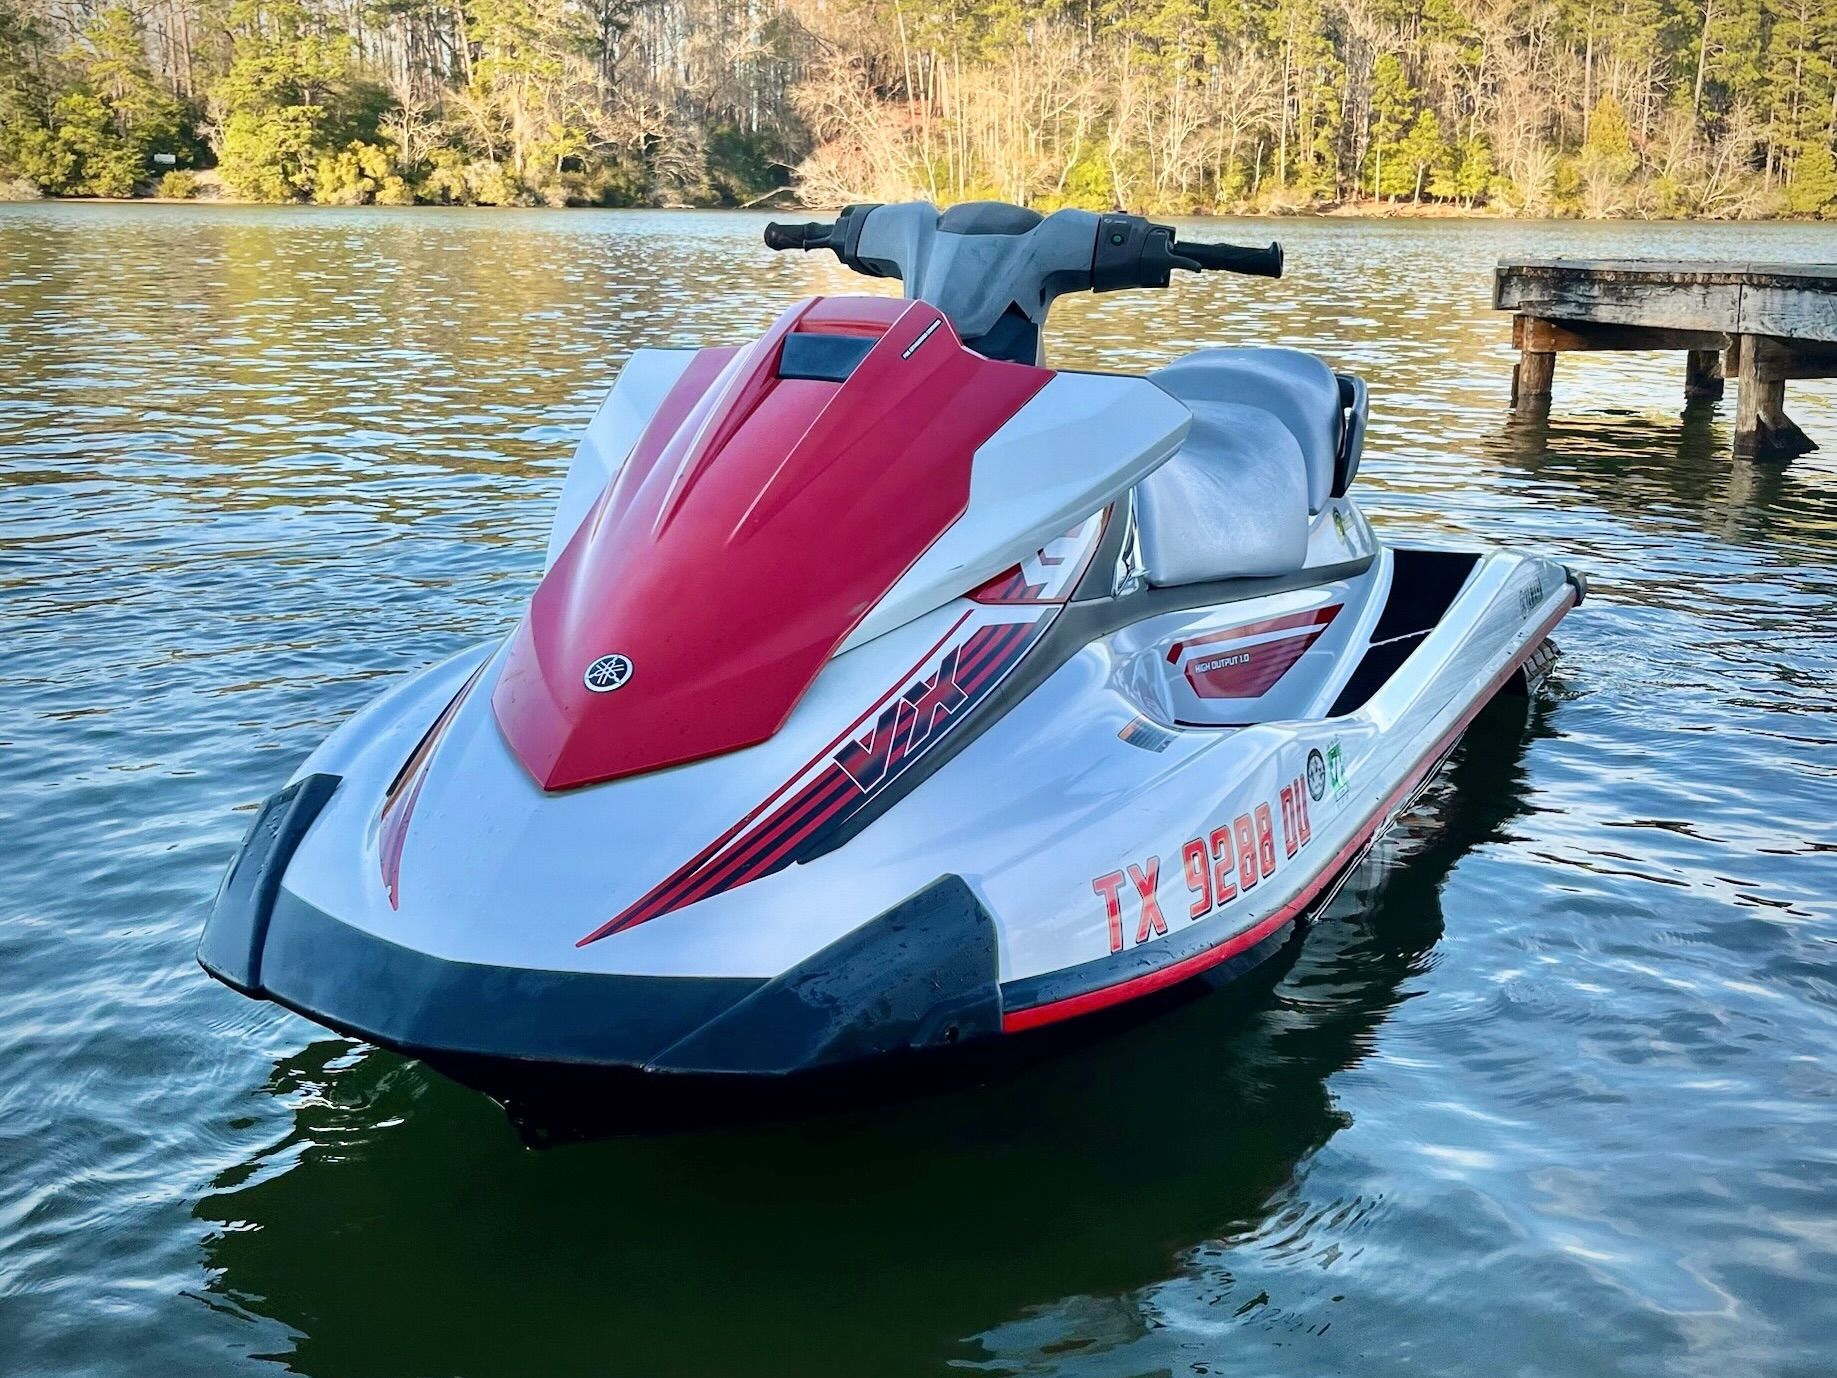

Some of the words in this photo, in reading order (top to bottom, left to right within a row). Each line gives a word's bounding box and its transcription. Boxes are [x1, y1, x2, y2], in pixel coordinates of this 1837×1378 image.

[833, 643, 969, 794] VX
[1194, 662, 1211, 673] HIGH
[1211, 655, 1238, 670] OUTPUT
[1092, 855, 1168, 954] TX
[1181, 801, 1276, 920] 9288
